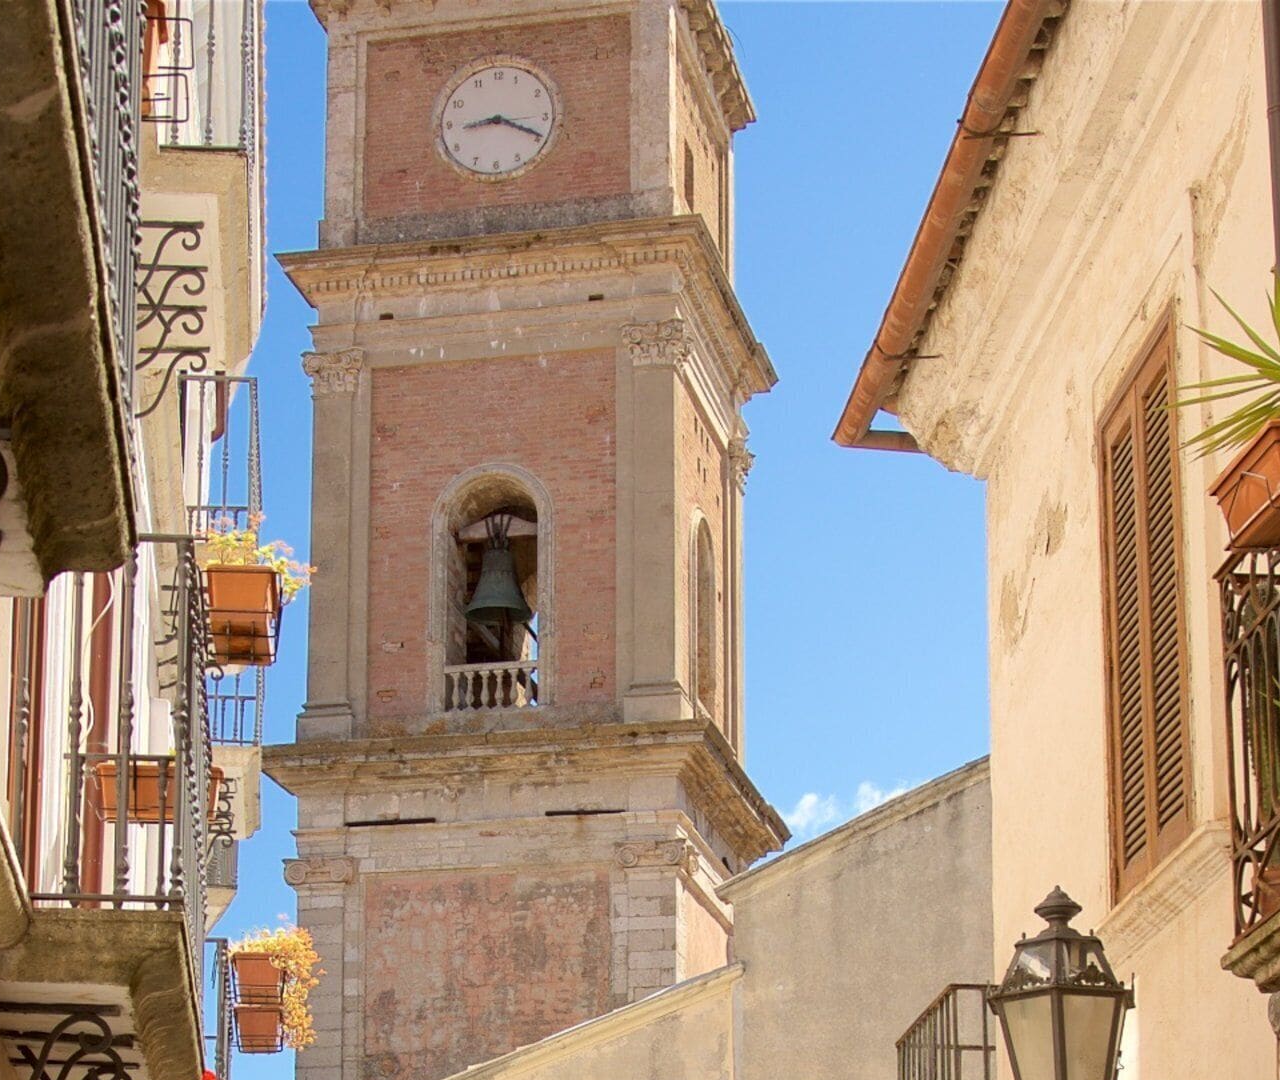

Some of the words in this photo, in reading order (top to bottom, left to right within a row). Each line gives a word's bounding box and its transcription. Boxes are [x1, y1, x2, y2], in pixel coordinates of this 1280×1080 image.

[493, 71, 504, 80] 12
[474, 79, 483, 88] 11
[534, 88, 541, 98] 2
[453, 100, 463, 108] 10
[542, 112, 549, 121] 3
[446, 121, 453, 130] 9
[453, 143, 460, 152] 8
[473, 156, 479, 166] 7
[514, 153, 521, 162] 5
[493, 160, 500, 169] 6
